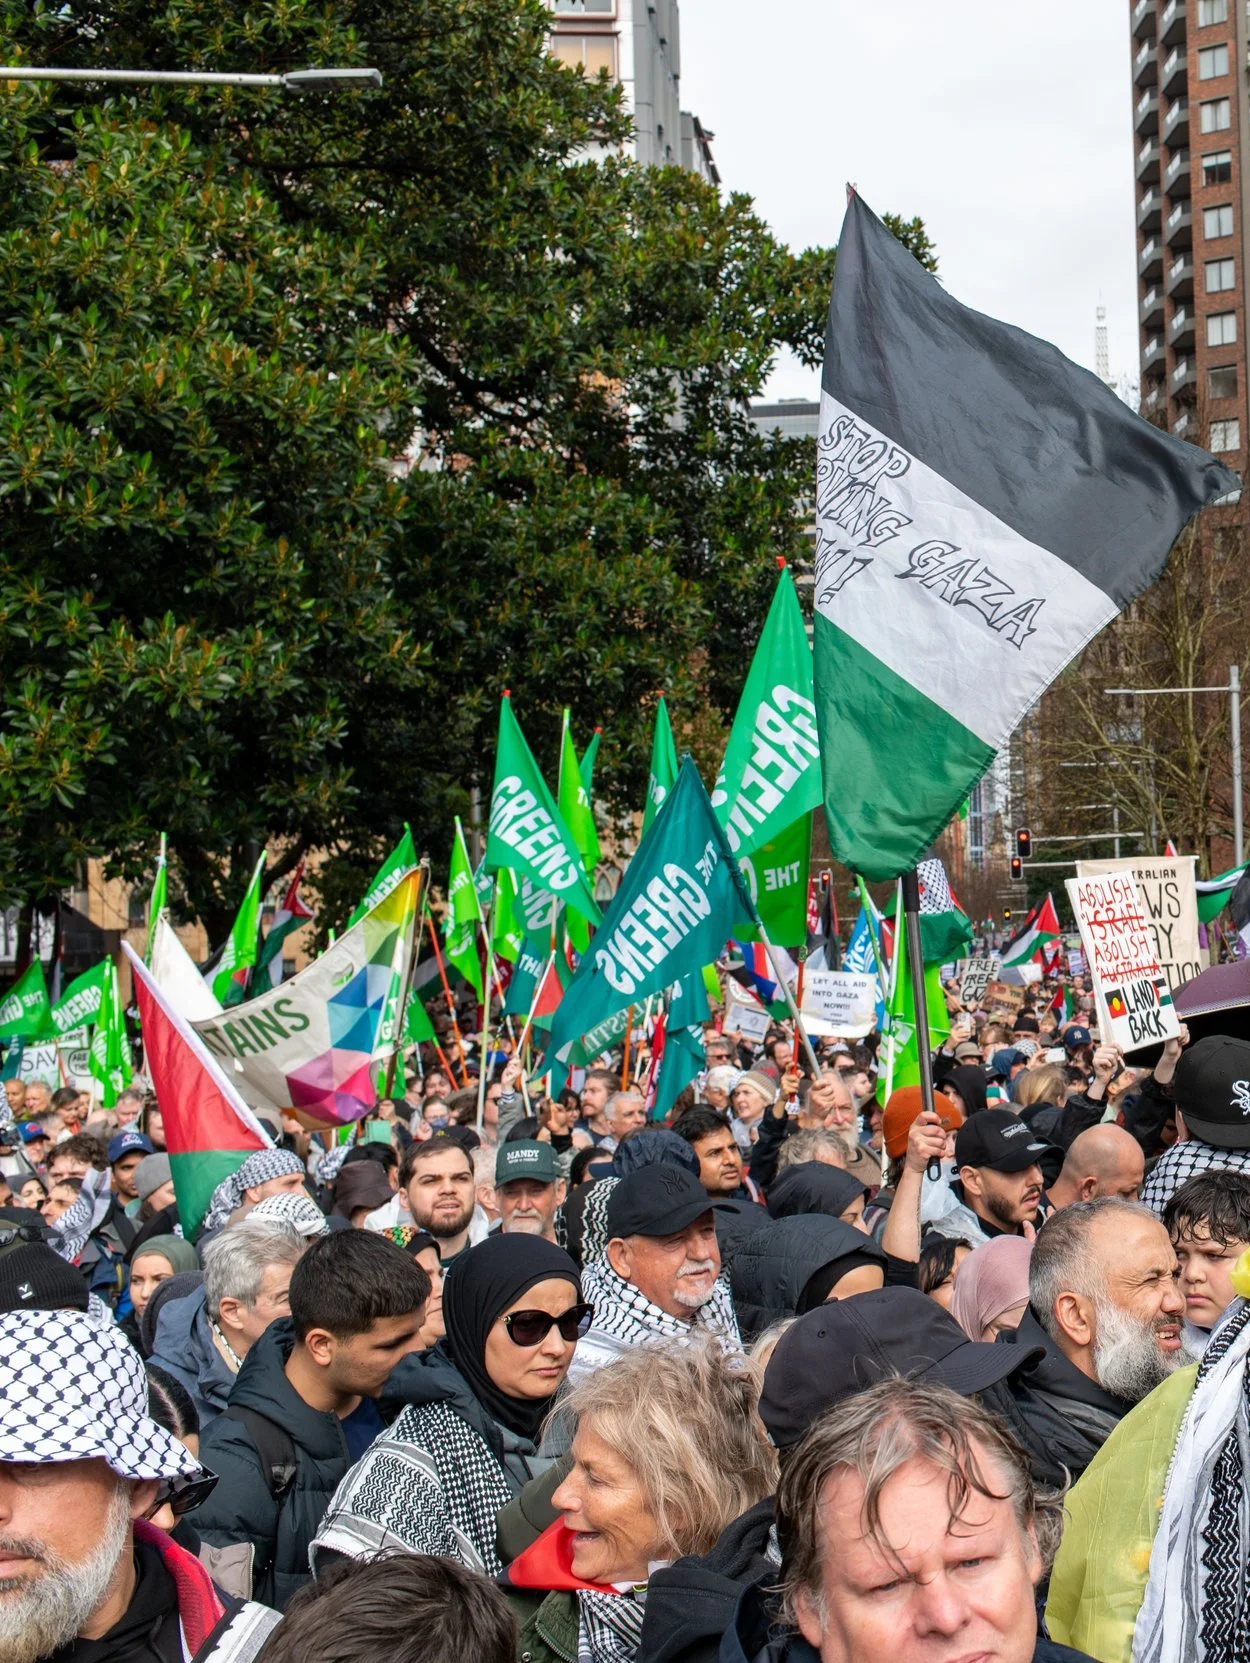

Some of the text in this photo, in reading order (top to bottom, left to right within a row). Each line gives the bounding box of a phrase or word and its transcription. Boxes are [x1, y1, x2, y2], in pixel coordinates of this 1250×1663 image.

[818, 415, 912, 490] STOP
[894, 539, 1046, 650] GAZA
[1077, 878, 1135, 910] ABOLISH
[1094, 934, 1151, 963] ABOLISH
[1149, 923, 1174, 960] AY
[968, 960, 999, 972] FREE
[812, 977, 868, 988] LET ALL AID
[812, 990, 860, 1000] INTO GAZA
[1121, 979, 1155, 1014] LAND
[202, 997, 311, 1058] NTAINS
[1128, 1009, 1168, 1044] BACK
[21, 1049, 58, 1073] SAV
[506, 1149, 540, 1160] MANDY
